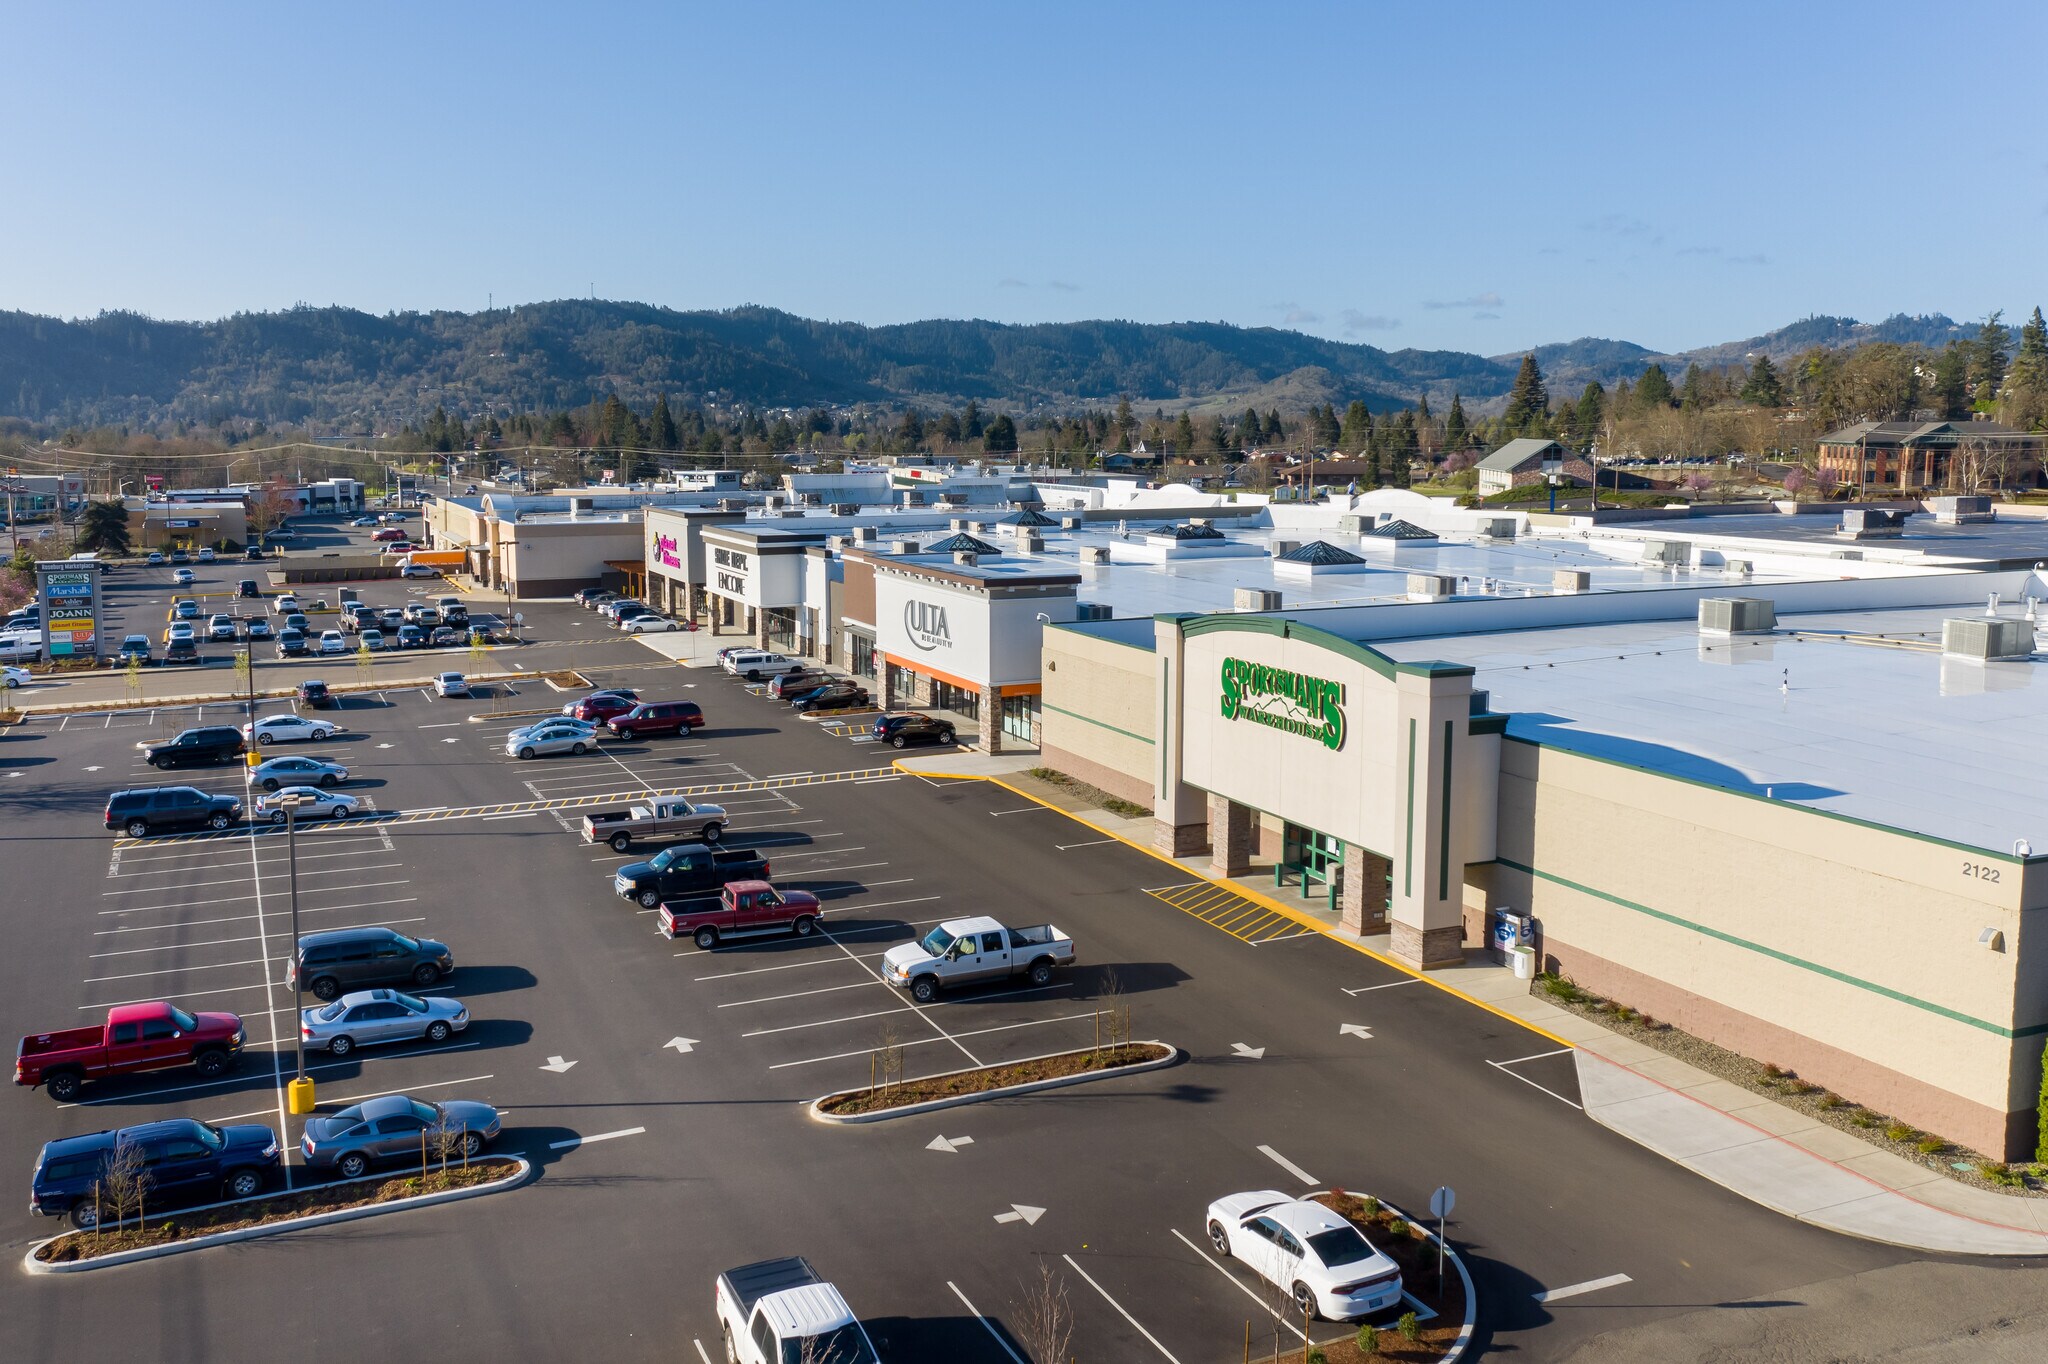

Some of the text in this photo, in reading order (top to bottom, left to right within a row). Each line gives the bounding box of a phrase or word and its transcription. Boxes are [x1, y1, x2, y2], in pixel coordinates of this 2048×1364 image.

[660, 535, 677, 552] planet
[715, 548, 730, 566] SHOE
[49, 586, 91, 595] Marshalls
[718, 572, 745, 596] ENCORE
[50, 610, 92, 618] JO-ANN
[907, 599, 951, 642] ULTA
[1239, 704, 1325, 742] WAREHOUSE
[1962, 862, 2001, 884] 2122
